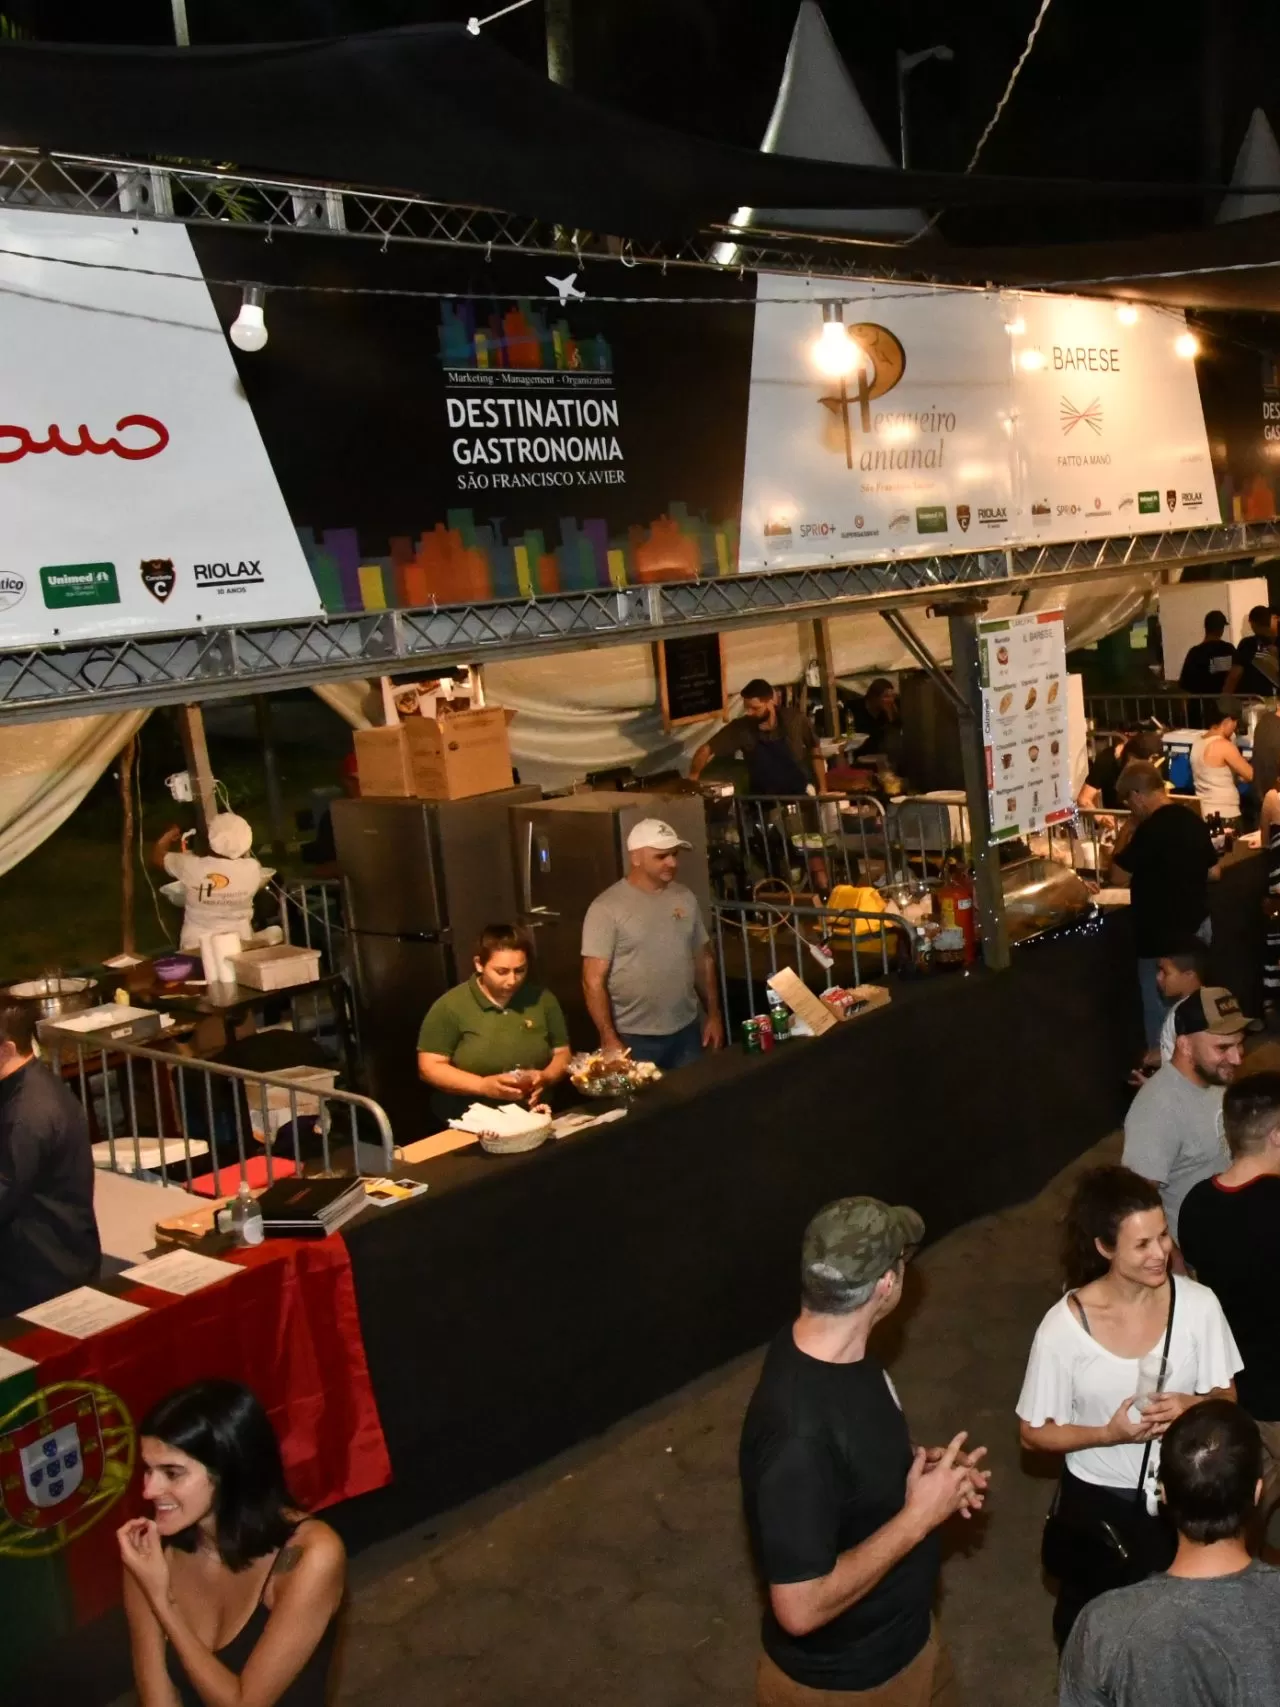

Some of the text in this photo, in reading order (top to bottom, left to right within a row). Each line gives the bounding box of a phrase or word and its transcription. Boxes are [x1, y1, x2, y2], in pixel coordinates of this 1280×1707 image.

[1052, 346, 1121, 372] BARESE
[448, 372, 494, 385] Marketing
[501, 373, 555, 385] Management
[562, 375, 612, 386] Organization
[446, 398, 620, 428] DESTINATION
[452, 437, 624, 465] GASTRONOMIA
[1057, 456, 1082, 467] FATTO
[1083, 456, 1090, 466] A
[457, 469, 627, 490] SÃO FRANCISCO XAVIER
[977, 508, 1007, 519] RIOLAX
[47, 572, 94, 586] Unimed
[194, 560, 262, 580] RIOLAX
